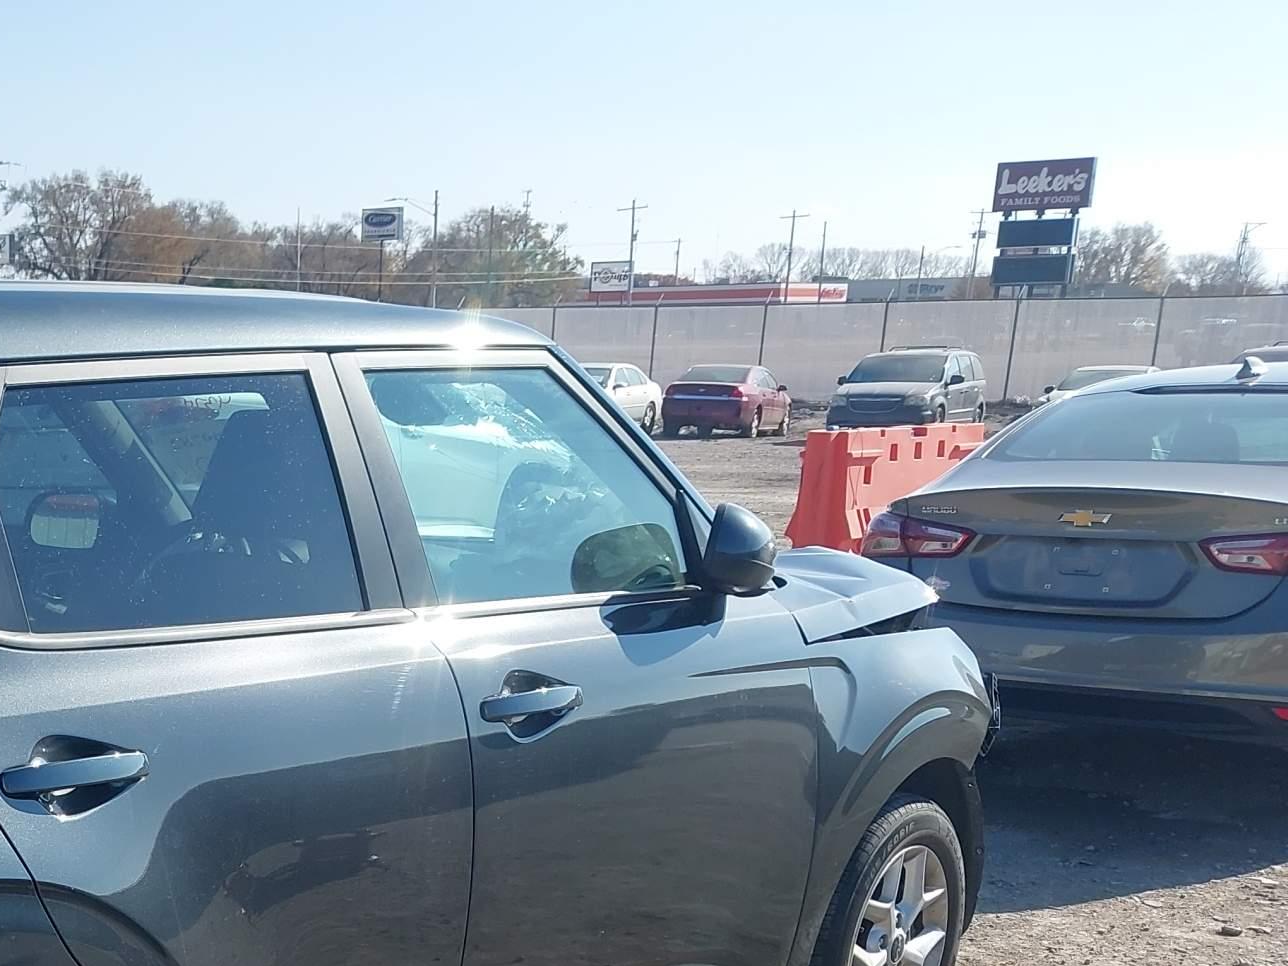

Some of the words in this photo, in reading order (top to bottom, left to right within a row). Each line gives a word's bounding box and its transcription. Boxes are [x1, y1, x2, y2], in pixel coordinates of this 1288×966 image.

[998, 167, 1089, 195] Leeker's
[1000, 196, 1041, 206] FAMILY
[1043, 195, 1081, 204] FOODS
